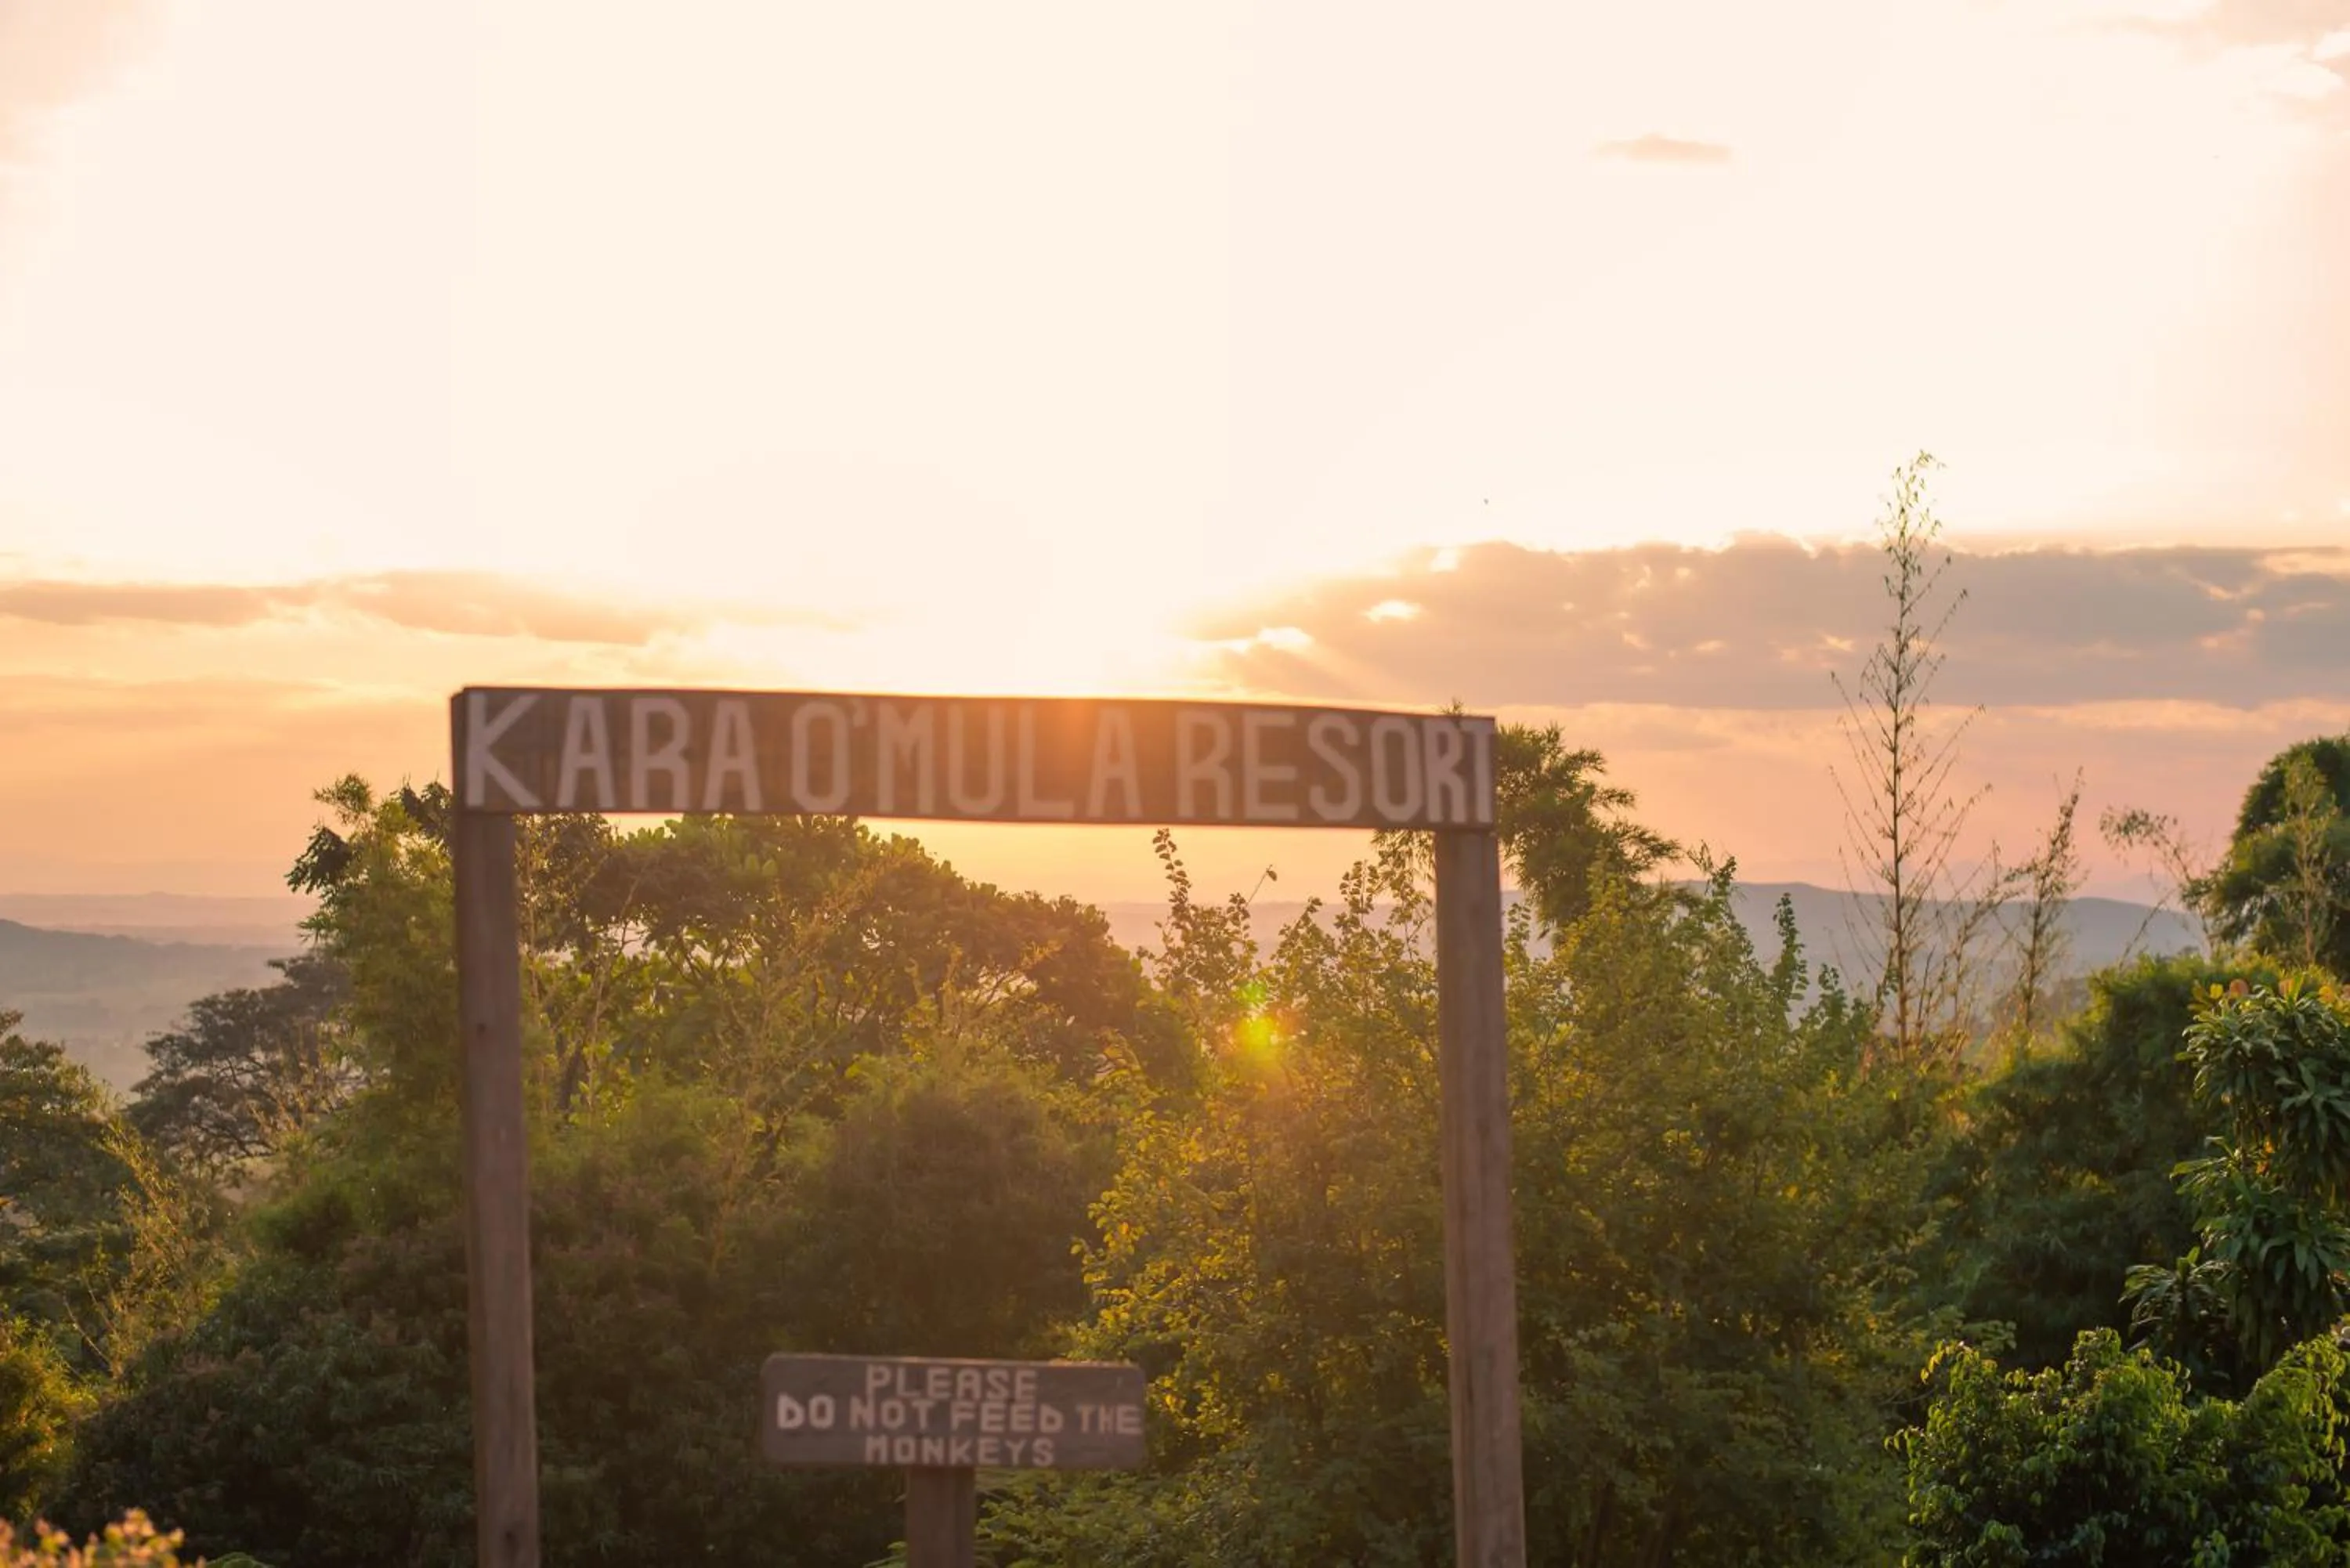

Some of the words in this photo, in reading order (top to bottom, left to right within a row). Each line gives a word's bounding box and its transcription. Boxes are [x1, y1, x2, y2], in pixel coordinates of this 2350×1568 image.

[465, 692, 761, 811] KARA
[790, 696, 1143, 820] O'MULA
[1177, 709, 1495, 824] RESORT
[866, 1364, 1038, 1401] PLEASE
[777, 1393, 836, 1429] DO
[849, 1394, 935, 1430] NOT
[949, 1400, 1064, 1433] FEED
[1076, 1404, 1143, 1435] THE
[865, 1435, 1054, 1465] MONKEYS
